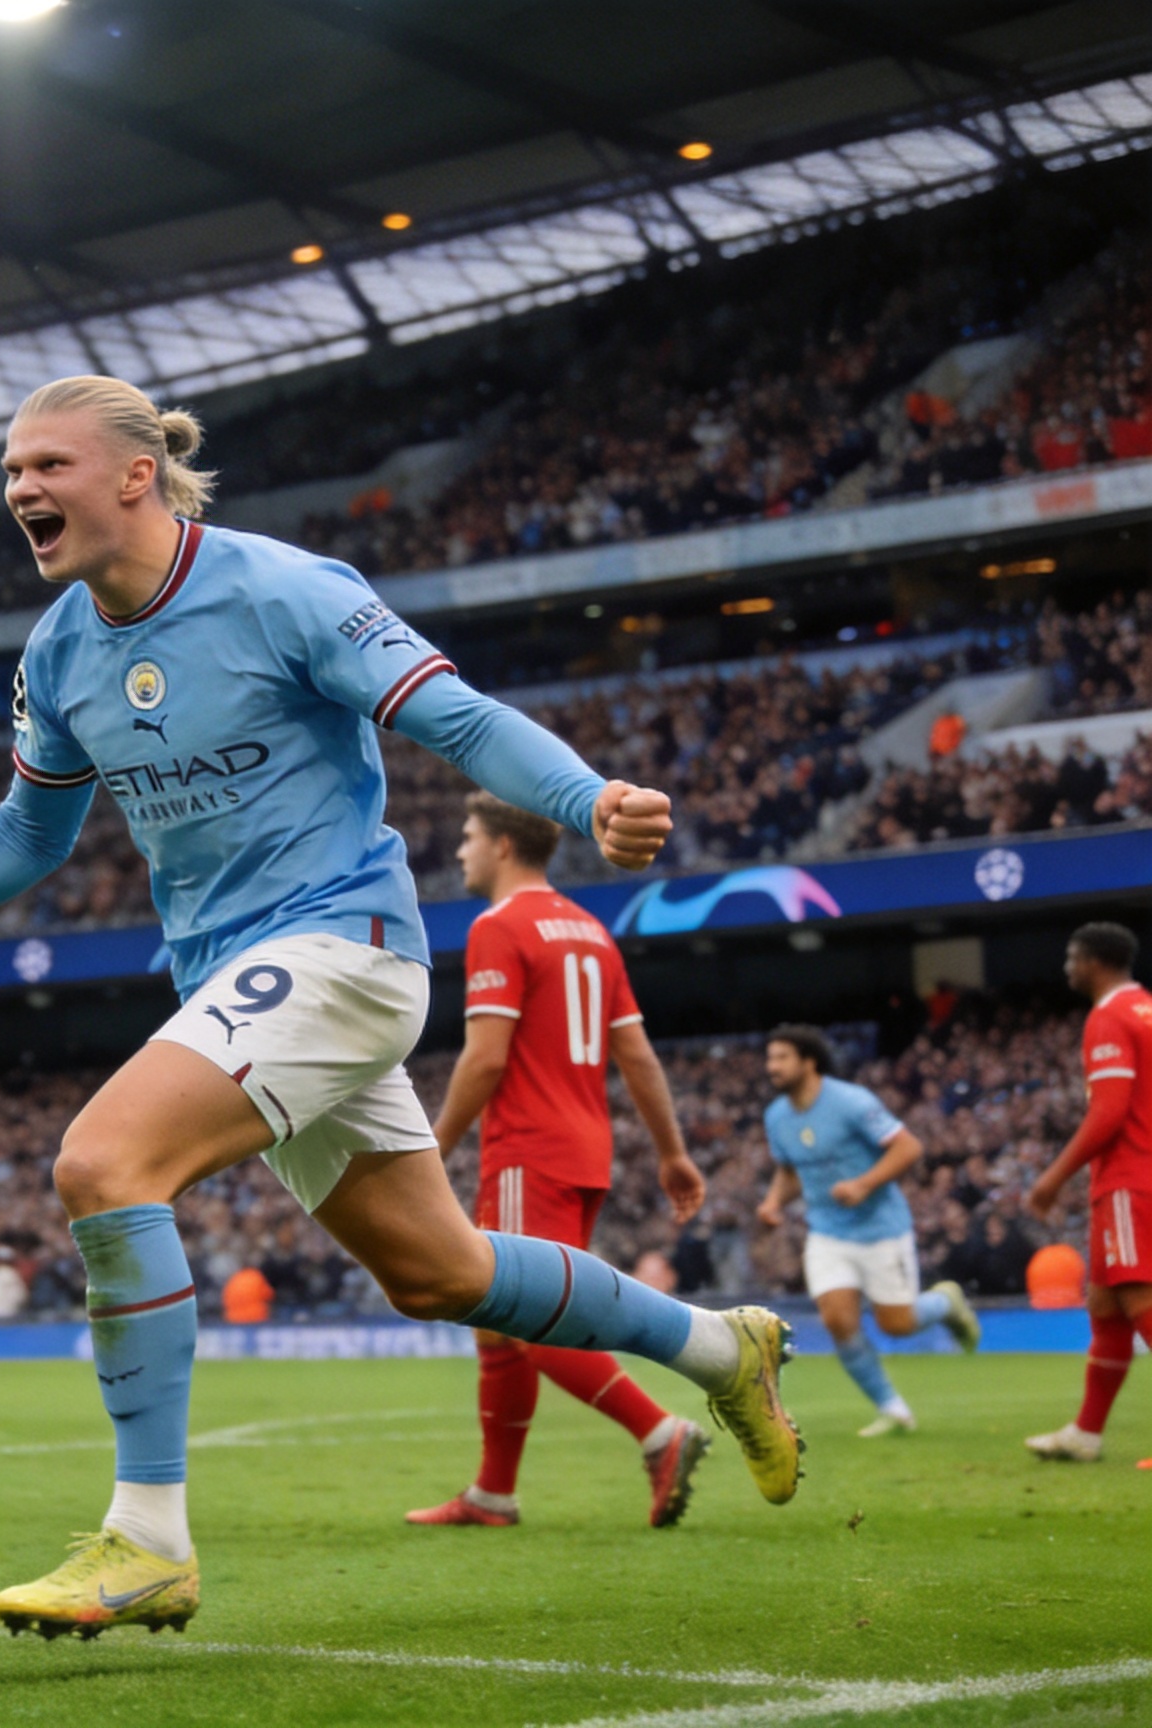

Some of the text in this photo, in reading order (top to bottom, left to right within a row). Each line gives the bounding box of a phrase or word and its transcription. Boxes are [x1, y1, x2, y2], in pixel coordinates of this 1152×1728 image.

[104, 741, 270, 796] ETIHAD
[228, 964, 294, 1014] 9
[564, 952, 601, 1066] 11
